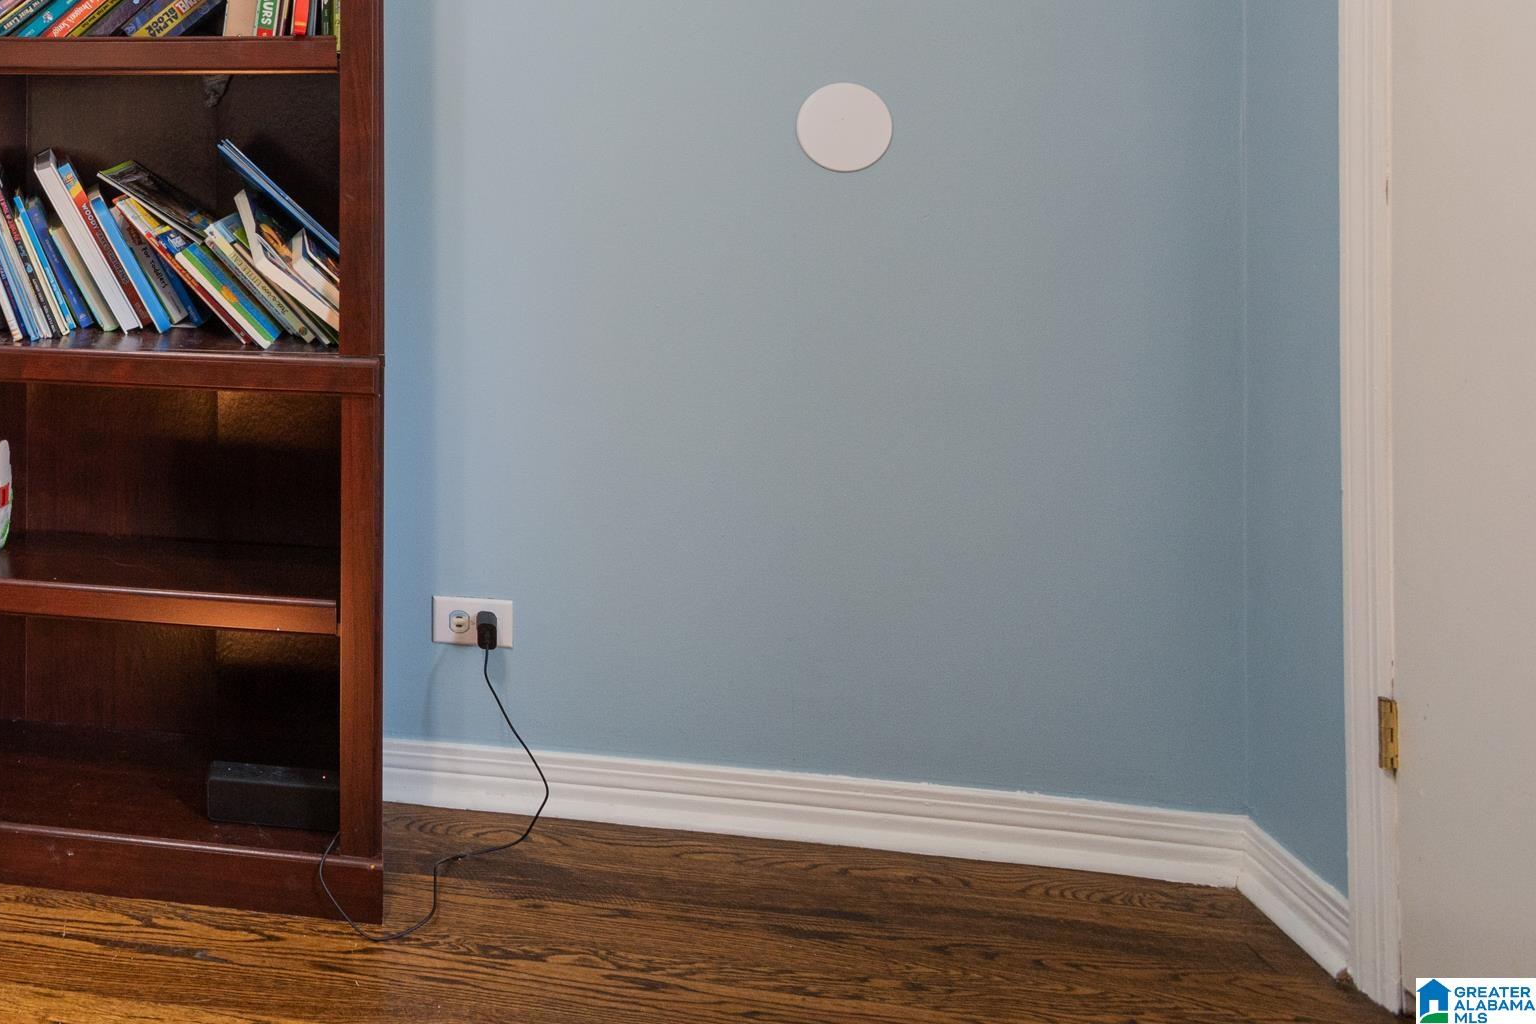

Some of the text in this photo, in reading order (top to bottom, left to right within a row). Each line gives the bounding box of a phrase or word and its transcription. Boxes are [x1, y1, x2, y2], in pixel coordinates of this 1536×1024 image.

[144, 6, 176, 33] BLOCK
[148, 12, 180, 38] ALPHA
[80, 202, 98, 229] WOODY
